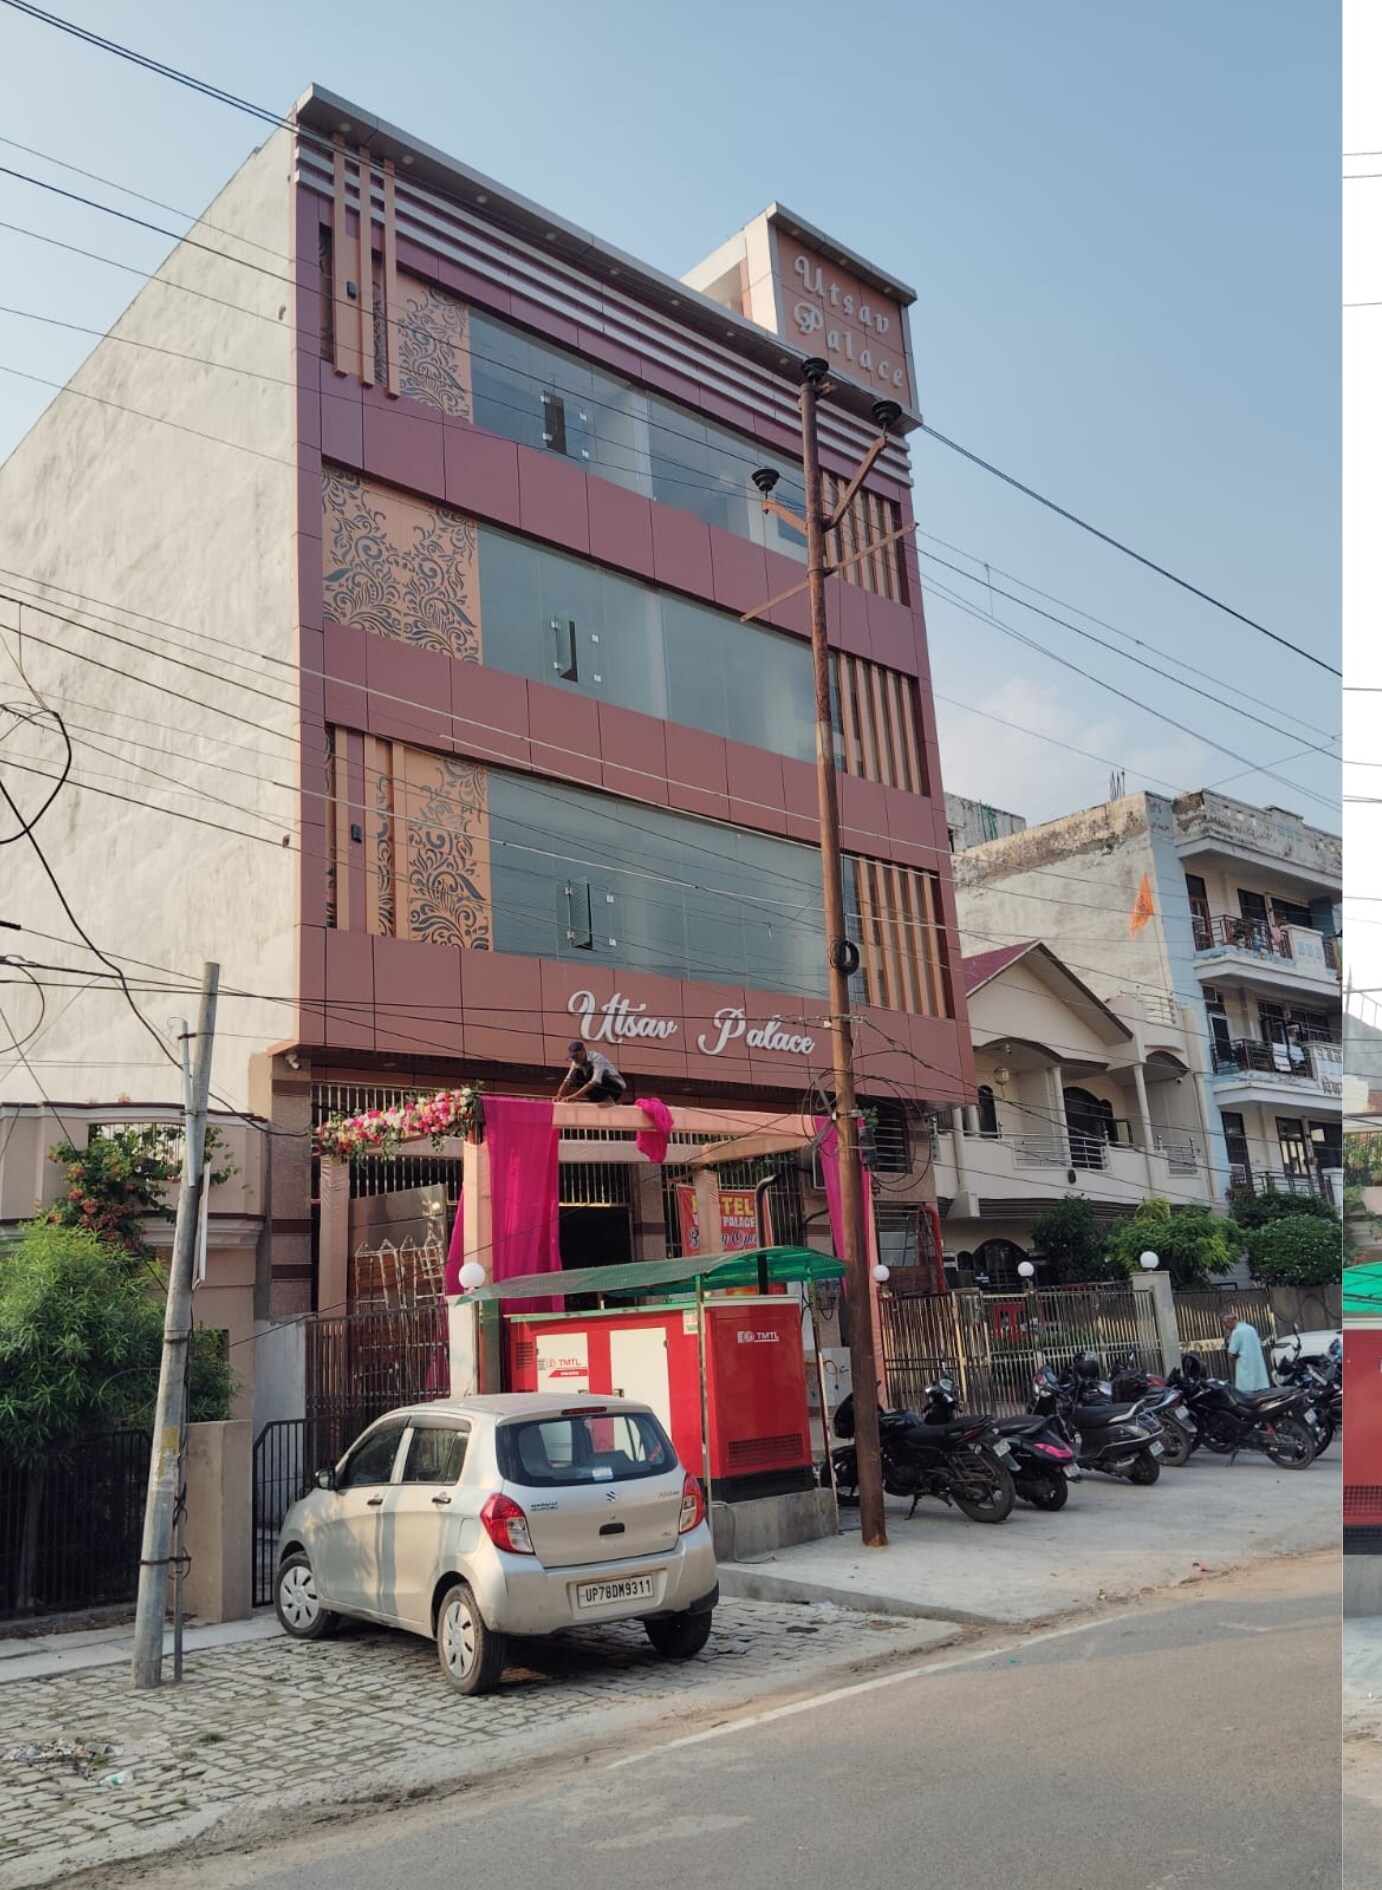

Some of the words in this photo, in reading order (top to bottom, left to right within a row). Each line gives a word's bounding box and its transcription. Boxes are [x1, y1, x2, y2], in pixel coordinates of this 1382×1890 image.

[794, 255, 889, 334] Utsav
[793, 302, 904, 388] Palace
[567, 990, 678, 1044] Utsav
[698, 1008, 815, 1055] Palace
[756, 1331, 780, 1340] TMTL
[585, 1579, 651, 1602] UP78DM9311
